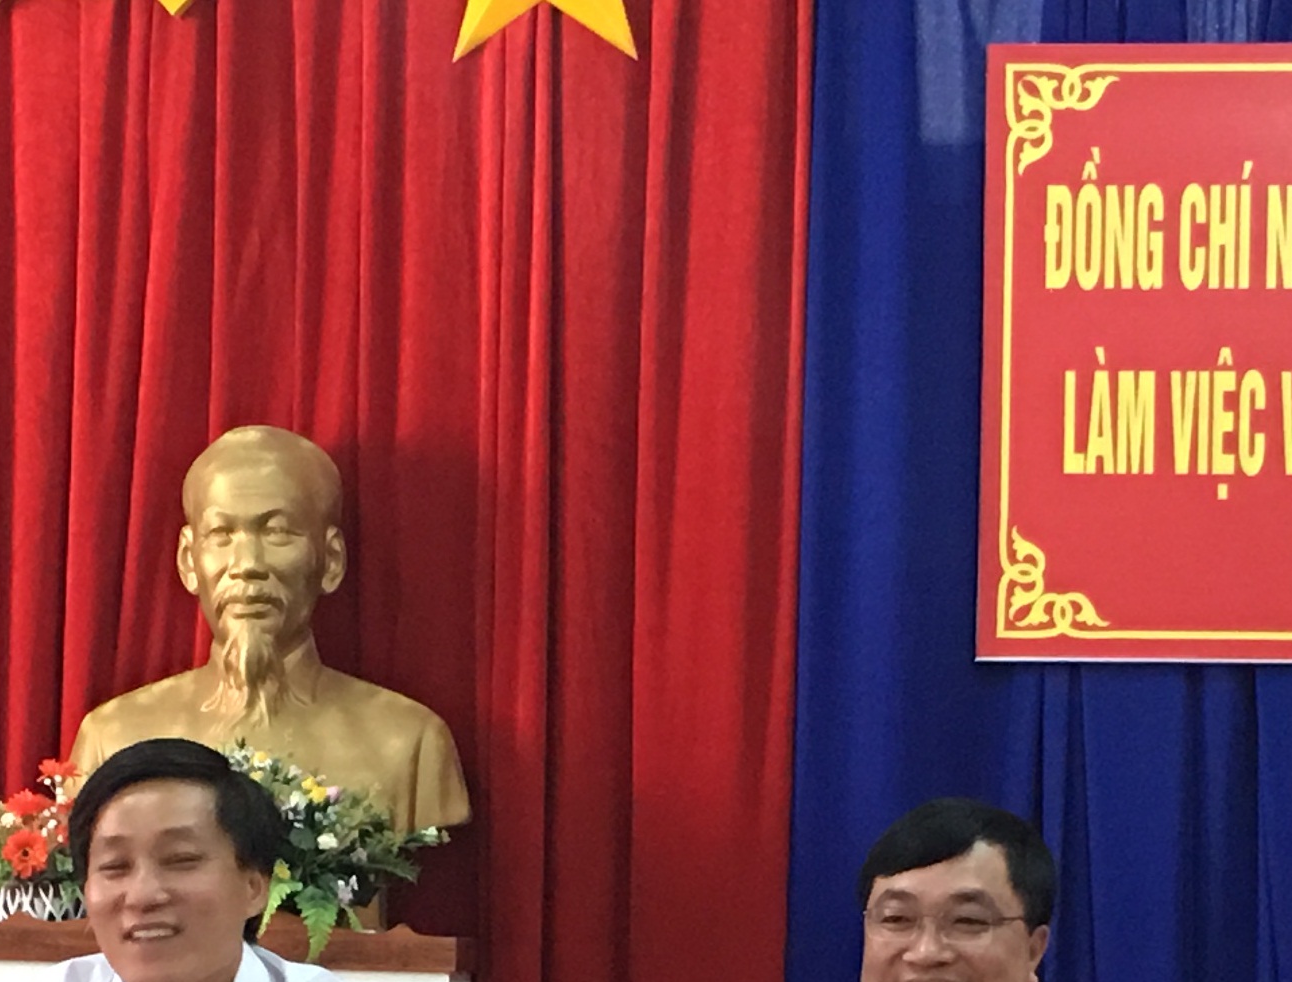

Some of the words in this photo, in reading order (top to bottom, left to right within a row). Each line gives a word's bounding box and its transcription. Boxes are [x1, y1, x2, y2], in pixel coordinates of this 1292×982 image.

[1044, 147, 1165, 291] ĐỒNG
[1178, 159, 1254, 292] CHÍ
[1063, 345, 1156, 476] LÀM
[1170, 346, 1267, 500] VIỆC
